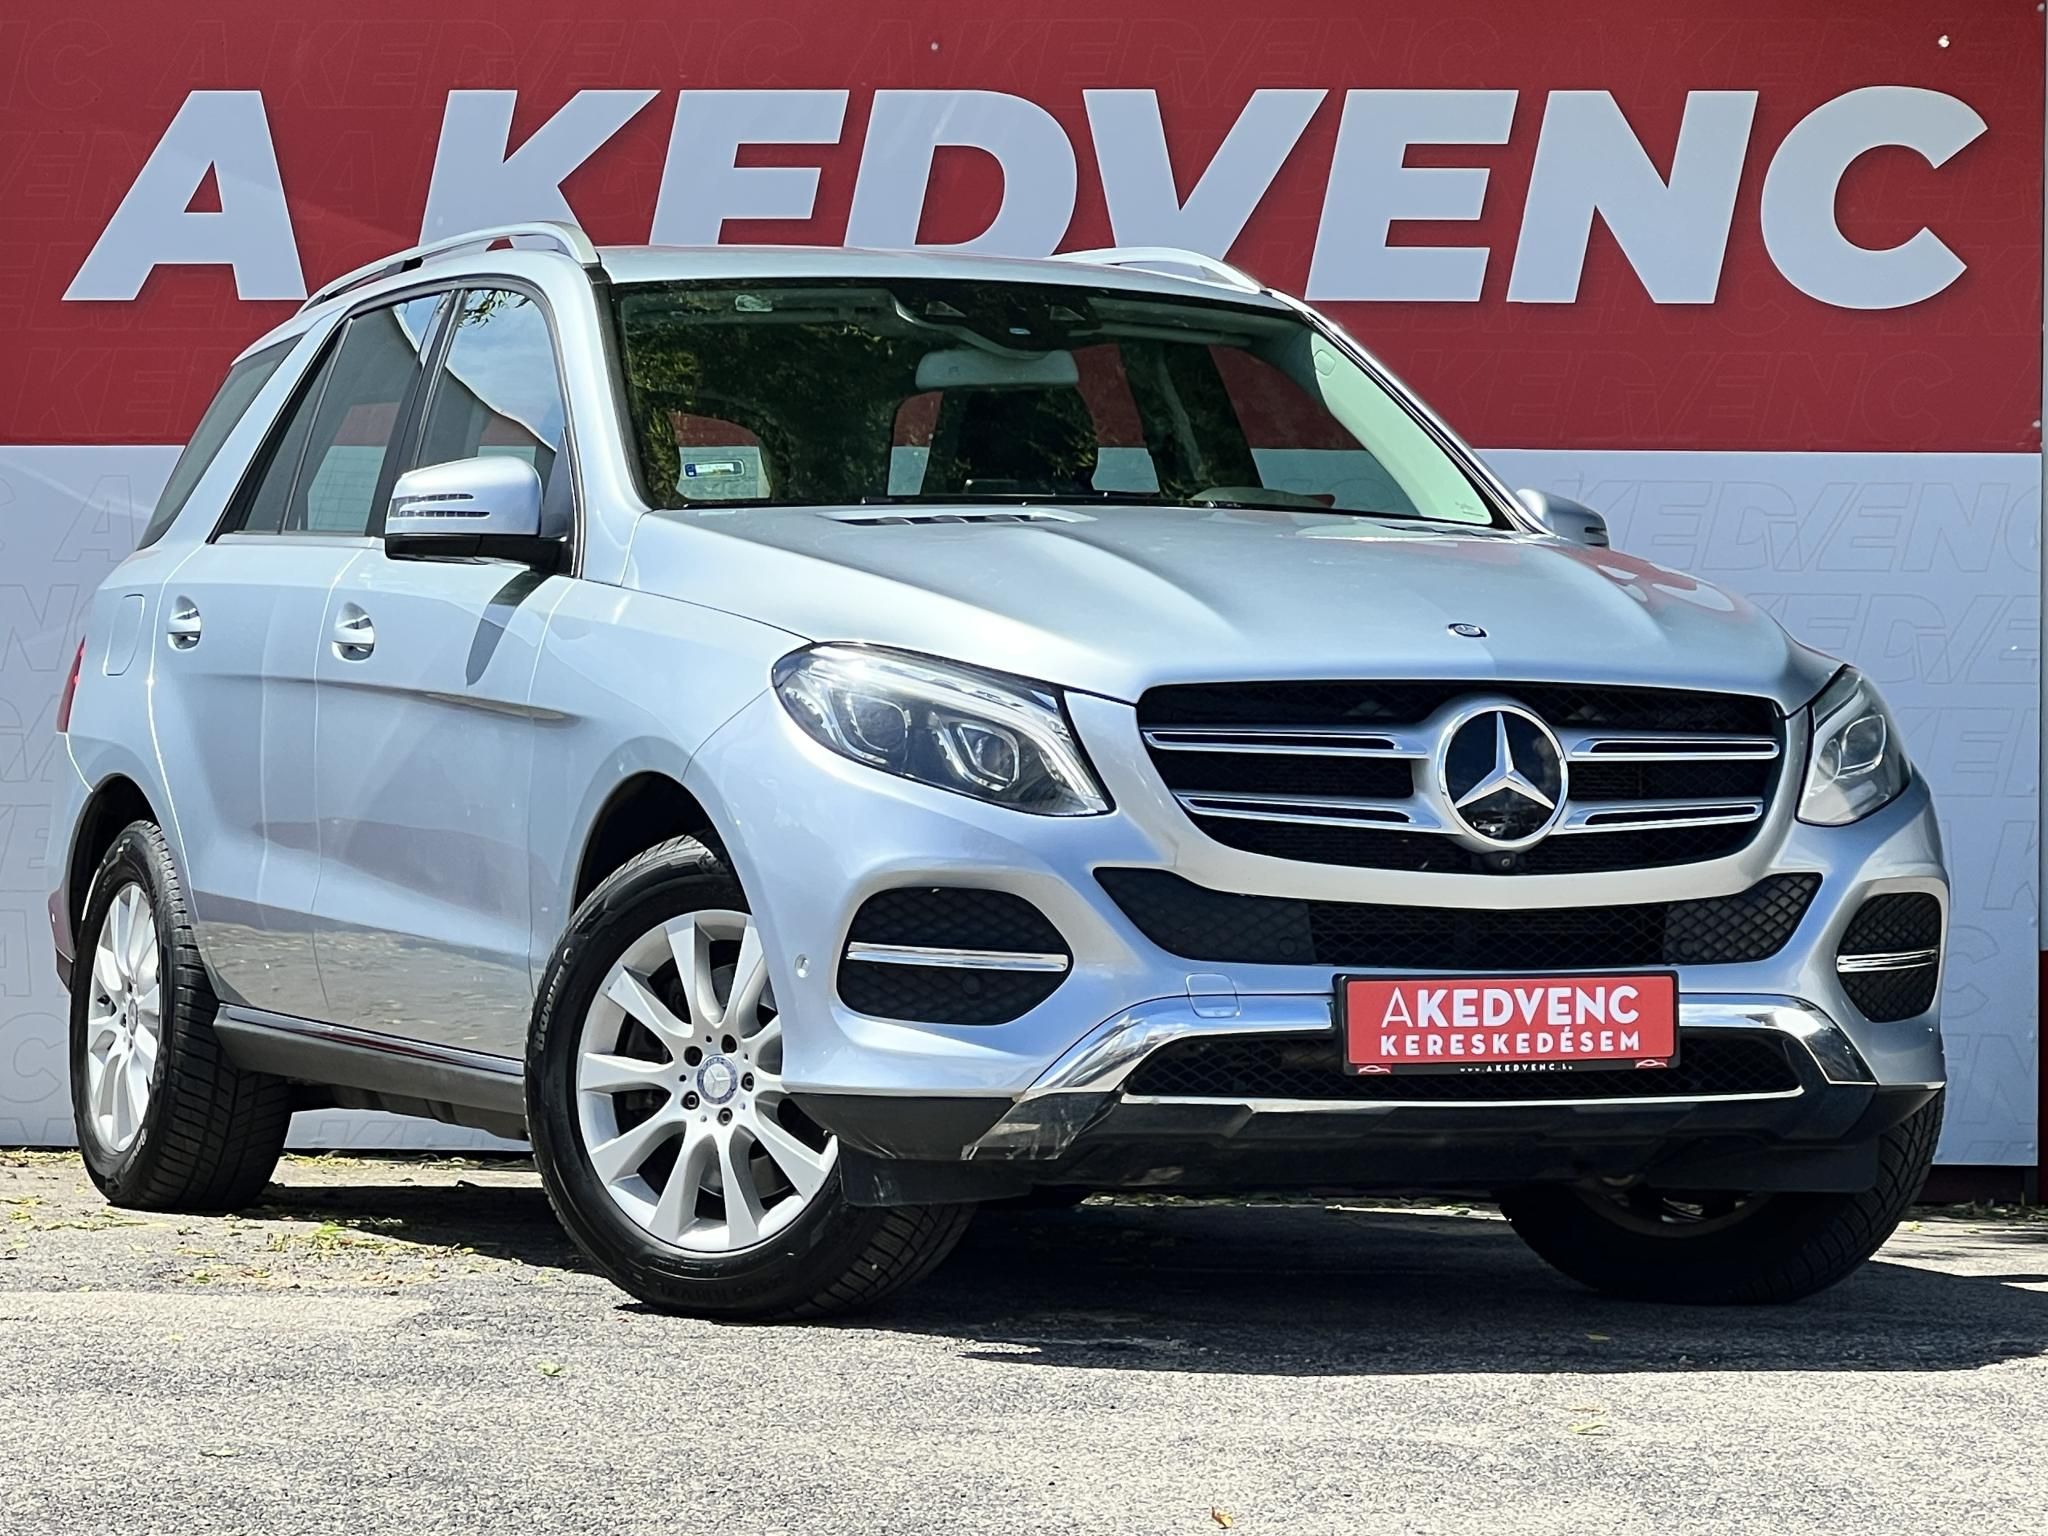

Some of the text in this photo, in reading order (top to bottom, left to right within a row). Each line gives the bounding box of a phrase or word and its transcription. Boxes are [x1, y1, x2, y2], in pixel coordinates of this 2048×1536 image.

[61, 89, 309, 301] A
[418, 86, 1989, 310] KEDVENC
[1380, 1025, 1640, 1057] KERESKEDÉSEM
